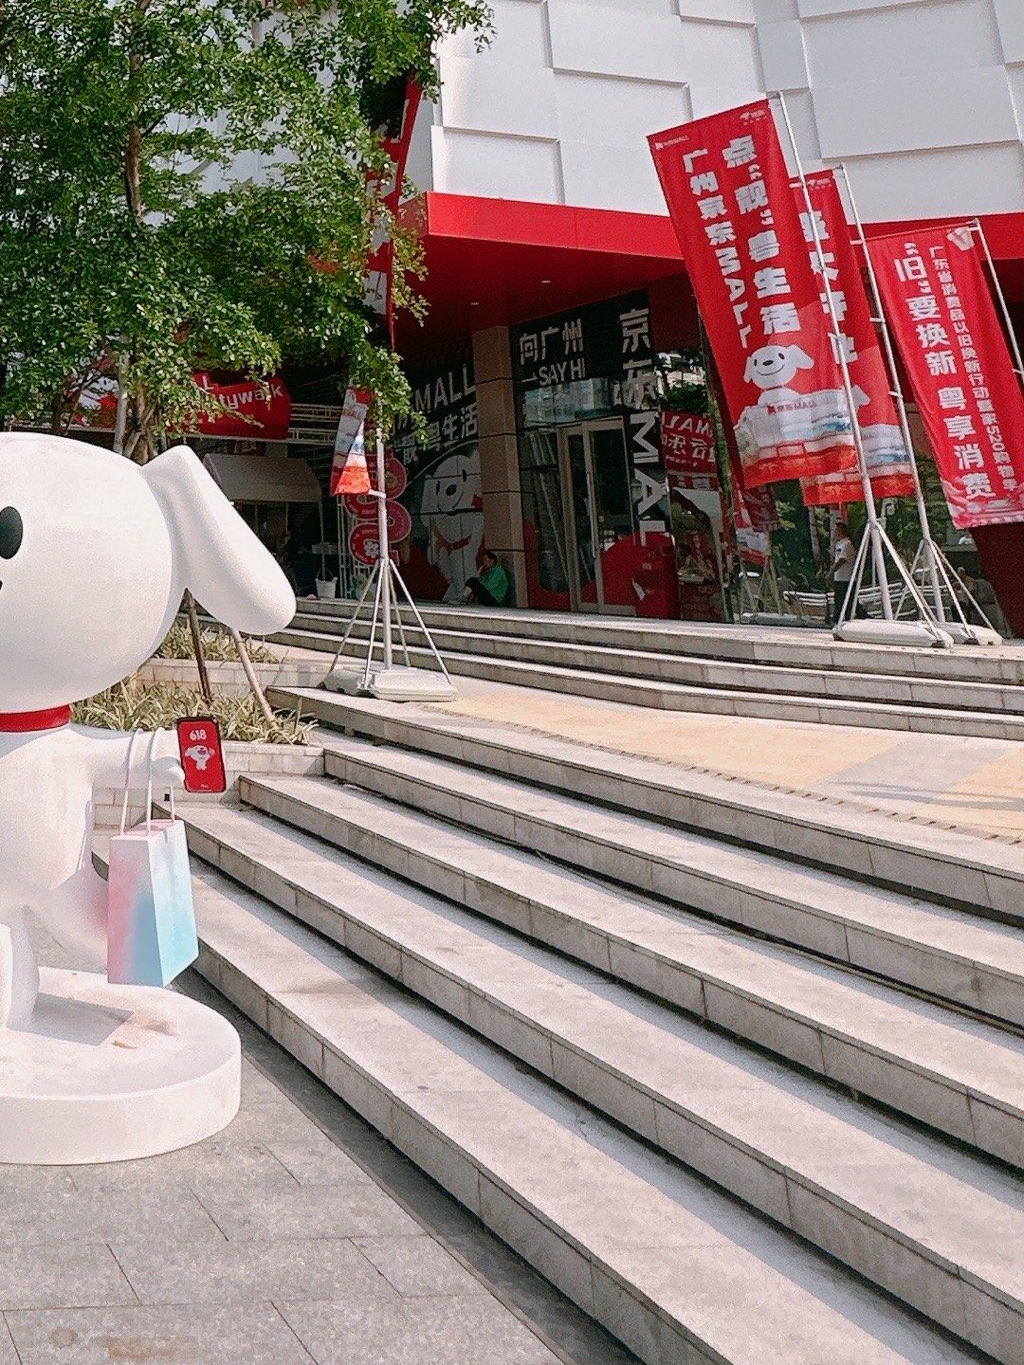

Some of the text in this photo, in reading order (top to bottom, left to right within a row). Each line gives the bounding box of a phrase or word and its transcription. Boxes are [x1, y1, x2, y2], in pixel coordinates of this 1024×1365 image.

[682, 148, 753, 349] 广州京东MALL
[519, 318, 584, 365] 向广州
[538, 357, 586, 386] SAY HI
[189, 729, 207, 740] 618
